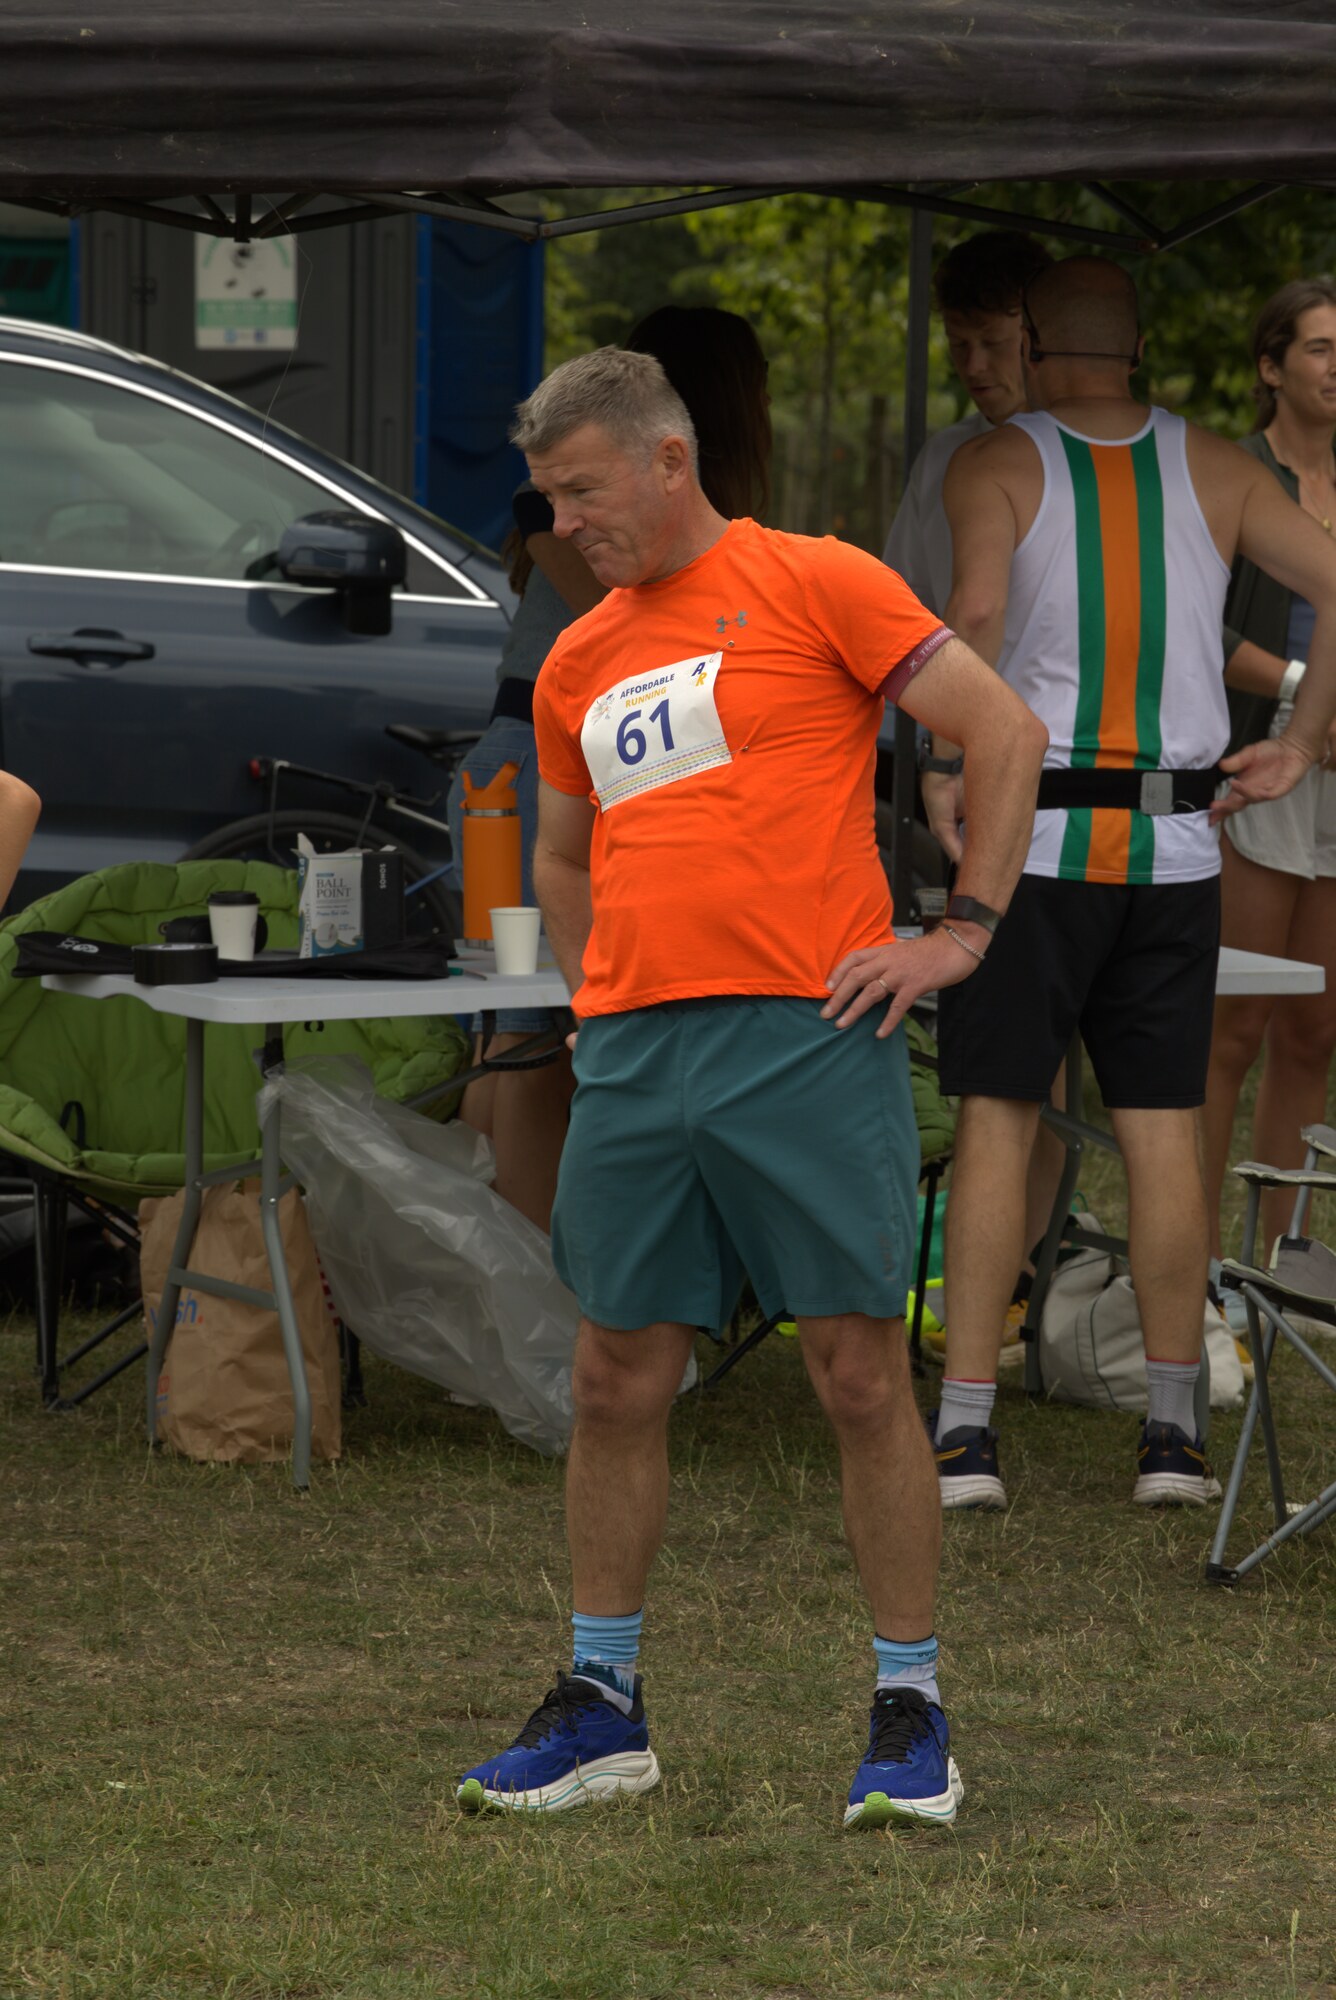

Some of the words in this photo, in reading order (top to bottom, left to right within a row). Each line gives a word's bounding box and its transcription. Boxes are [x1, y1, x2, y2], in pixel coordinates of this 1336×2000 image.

[620, 673, 675, 699] AFFORDABLE
[625, 687, 667, 708] RUNNING
[616, 698, 675, 765] 61
[316, 878, 348, 889] BALL
[316, 887, 352, 898] POINT
